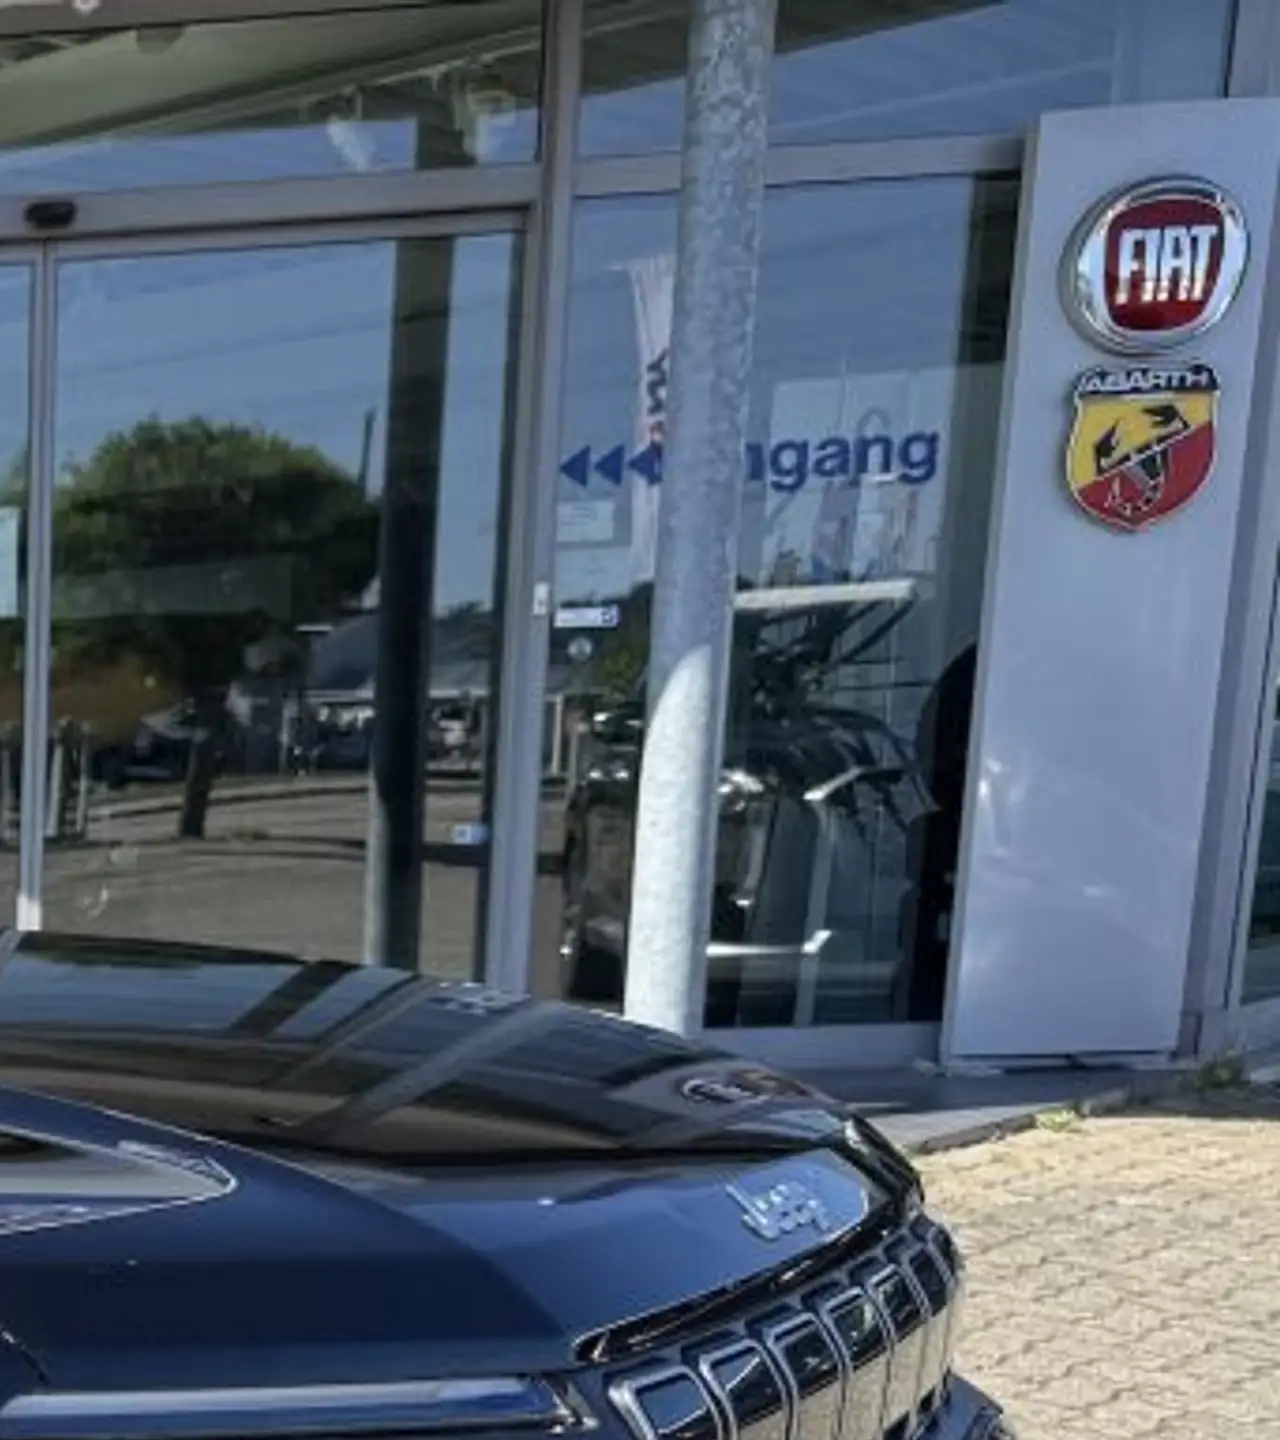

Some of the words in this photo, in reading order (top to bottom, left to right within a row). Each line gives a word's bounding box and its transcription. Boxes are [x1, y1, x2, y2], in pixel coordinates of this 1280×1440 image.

[1114, 225, 1219, 306] FIAT
[1080, 369, 1209, 392] ABARTH
[745, 429, 940, 493] gang
